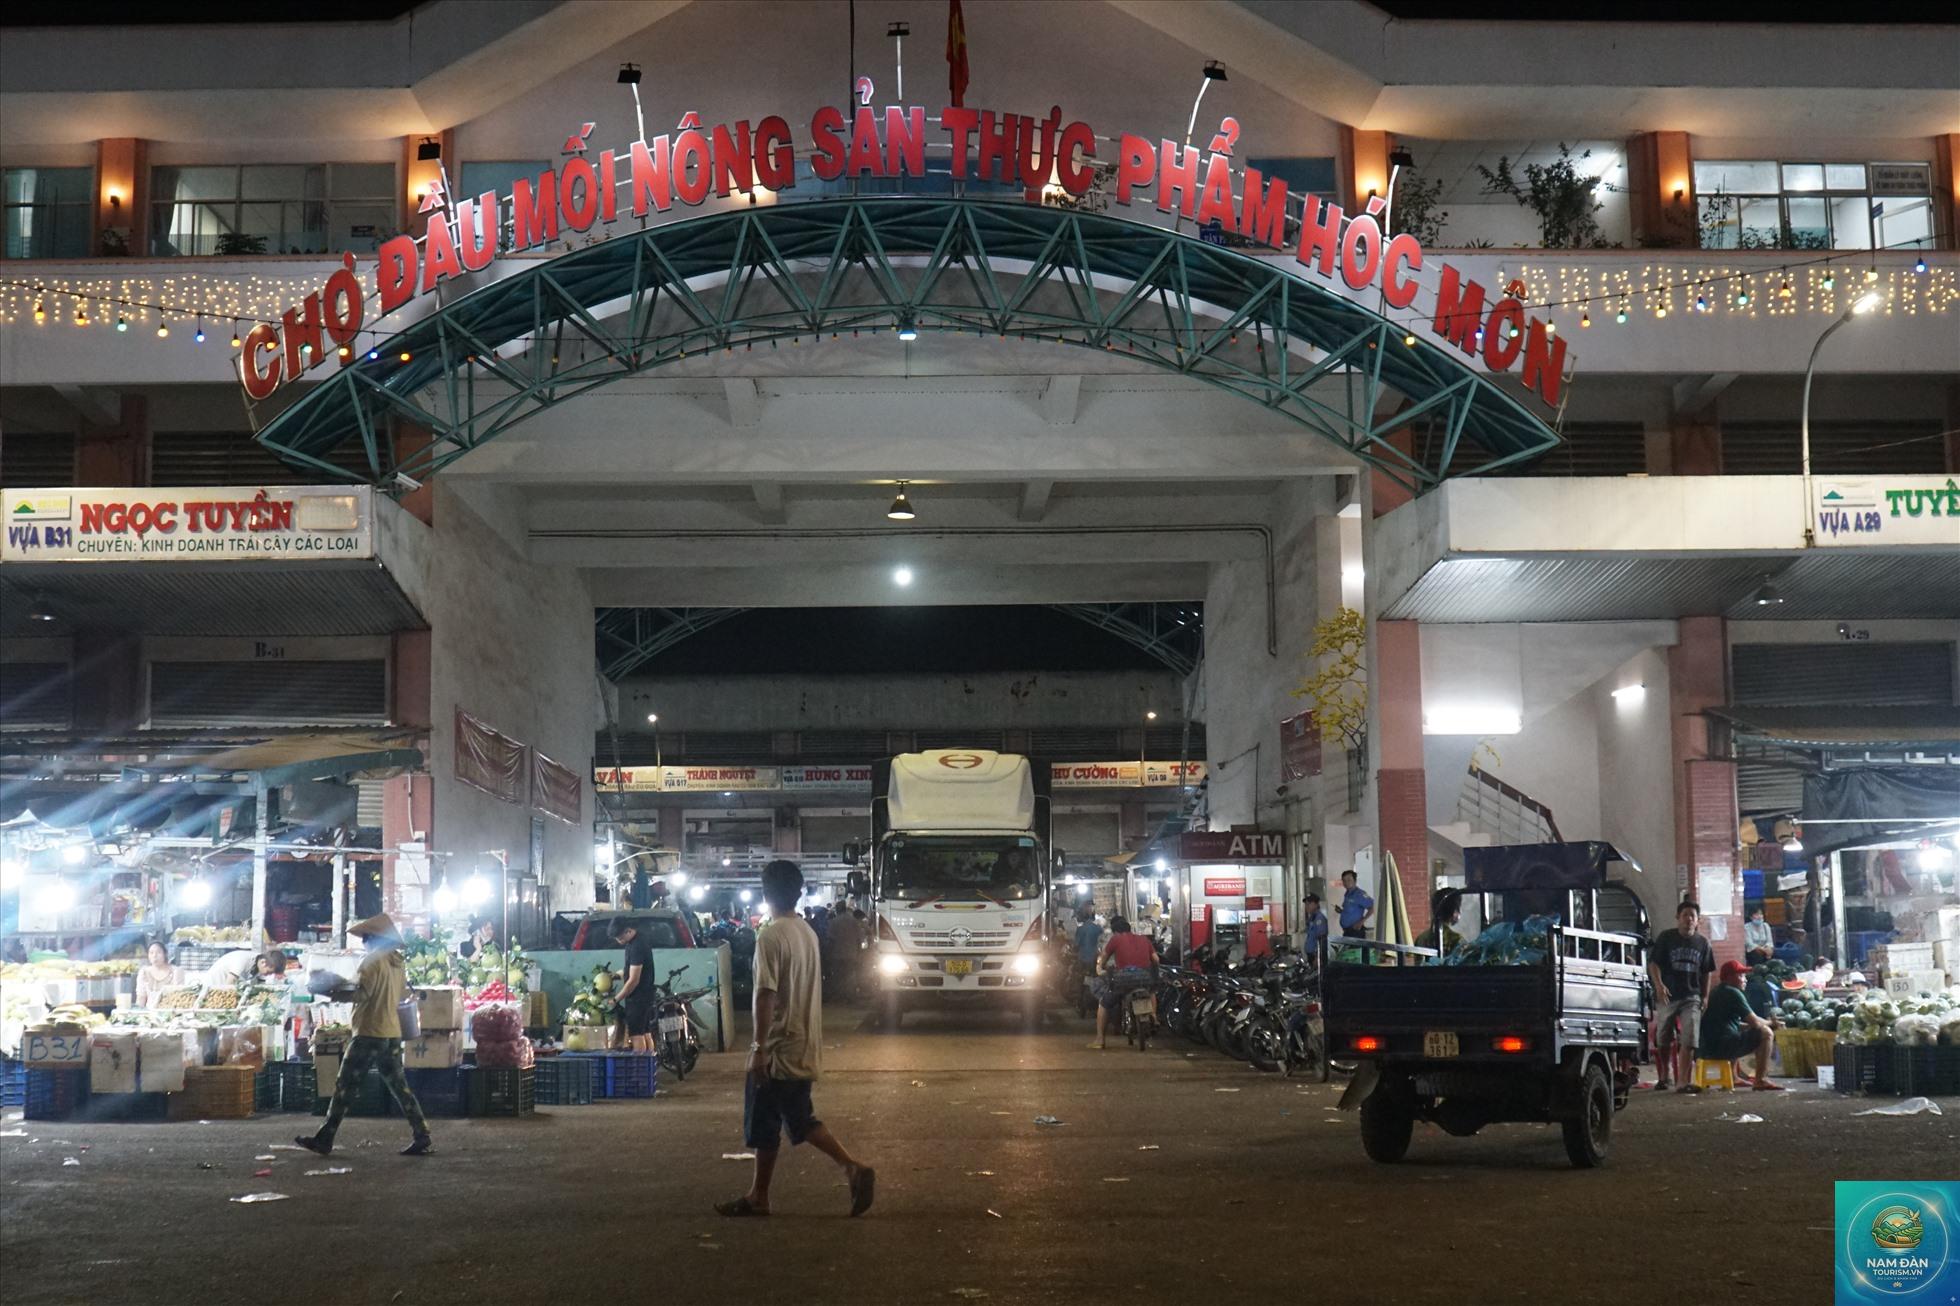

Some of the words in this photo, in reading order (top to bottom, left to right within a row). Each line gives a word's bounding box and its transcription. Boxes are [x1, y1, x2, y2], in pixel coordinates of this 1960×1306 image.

[240, 250, 364, 400] CHỢ
[376, 179, 497, 317] ĐẦU
[512, 122, 617, 249] MỐI
[630, 111, 795, 218] NÔNG
[811, 76, 925, 180] SẢN
[941, 105, 1097, 200] THỰC
[1116, 116, 1289, 251] PHẨM
[1295, 195, 1423, 309] HÓC
[1432, 263, 1567, 408] MÔN
[79, 503, 178, 541] NGỌC
[1819, 508, 1850, 538] VỰA
[1854, 511, 1882, 533] A29
[9, 523, 40, 553] VỰA
[44, 526, 72, 548] B31
[141, 540, 173, 553] KINH
[177, 538, 225, 552] DOANH
[229, 536, 262, 552] TRÁI
[263, 535, 291, 552] CÂY
[294, 535, 325, 551] CÁC
[327, 537, 359, 553] LOẠI
[1228, 835, 1283, 856] ATM
[29, 1035, 83, 1061] B31
